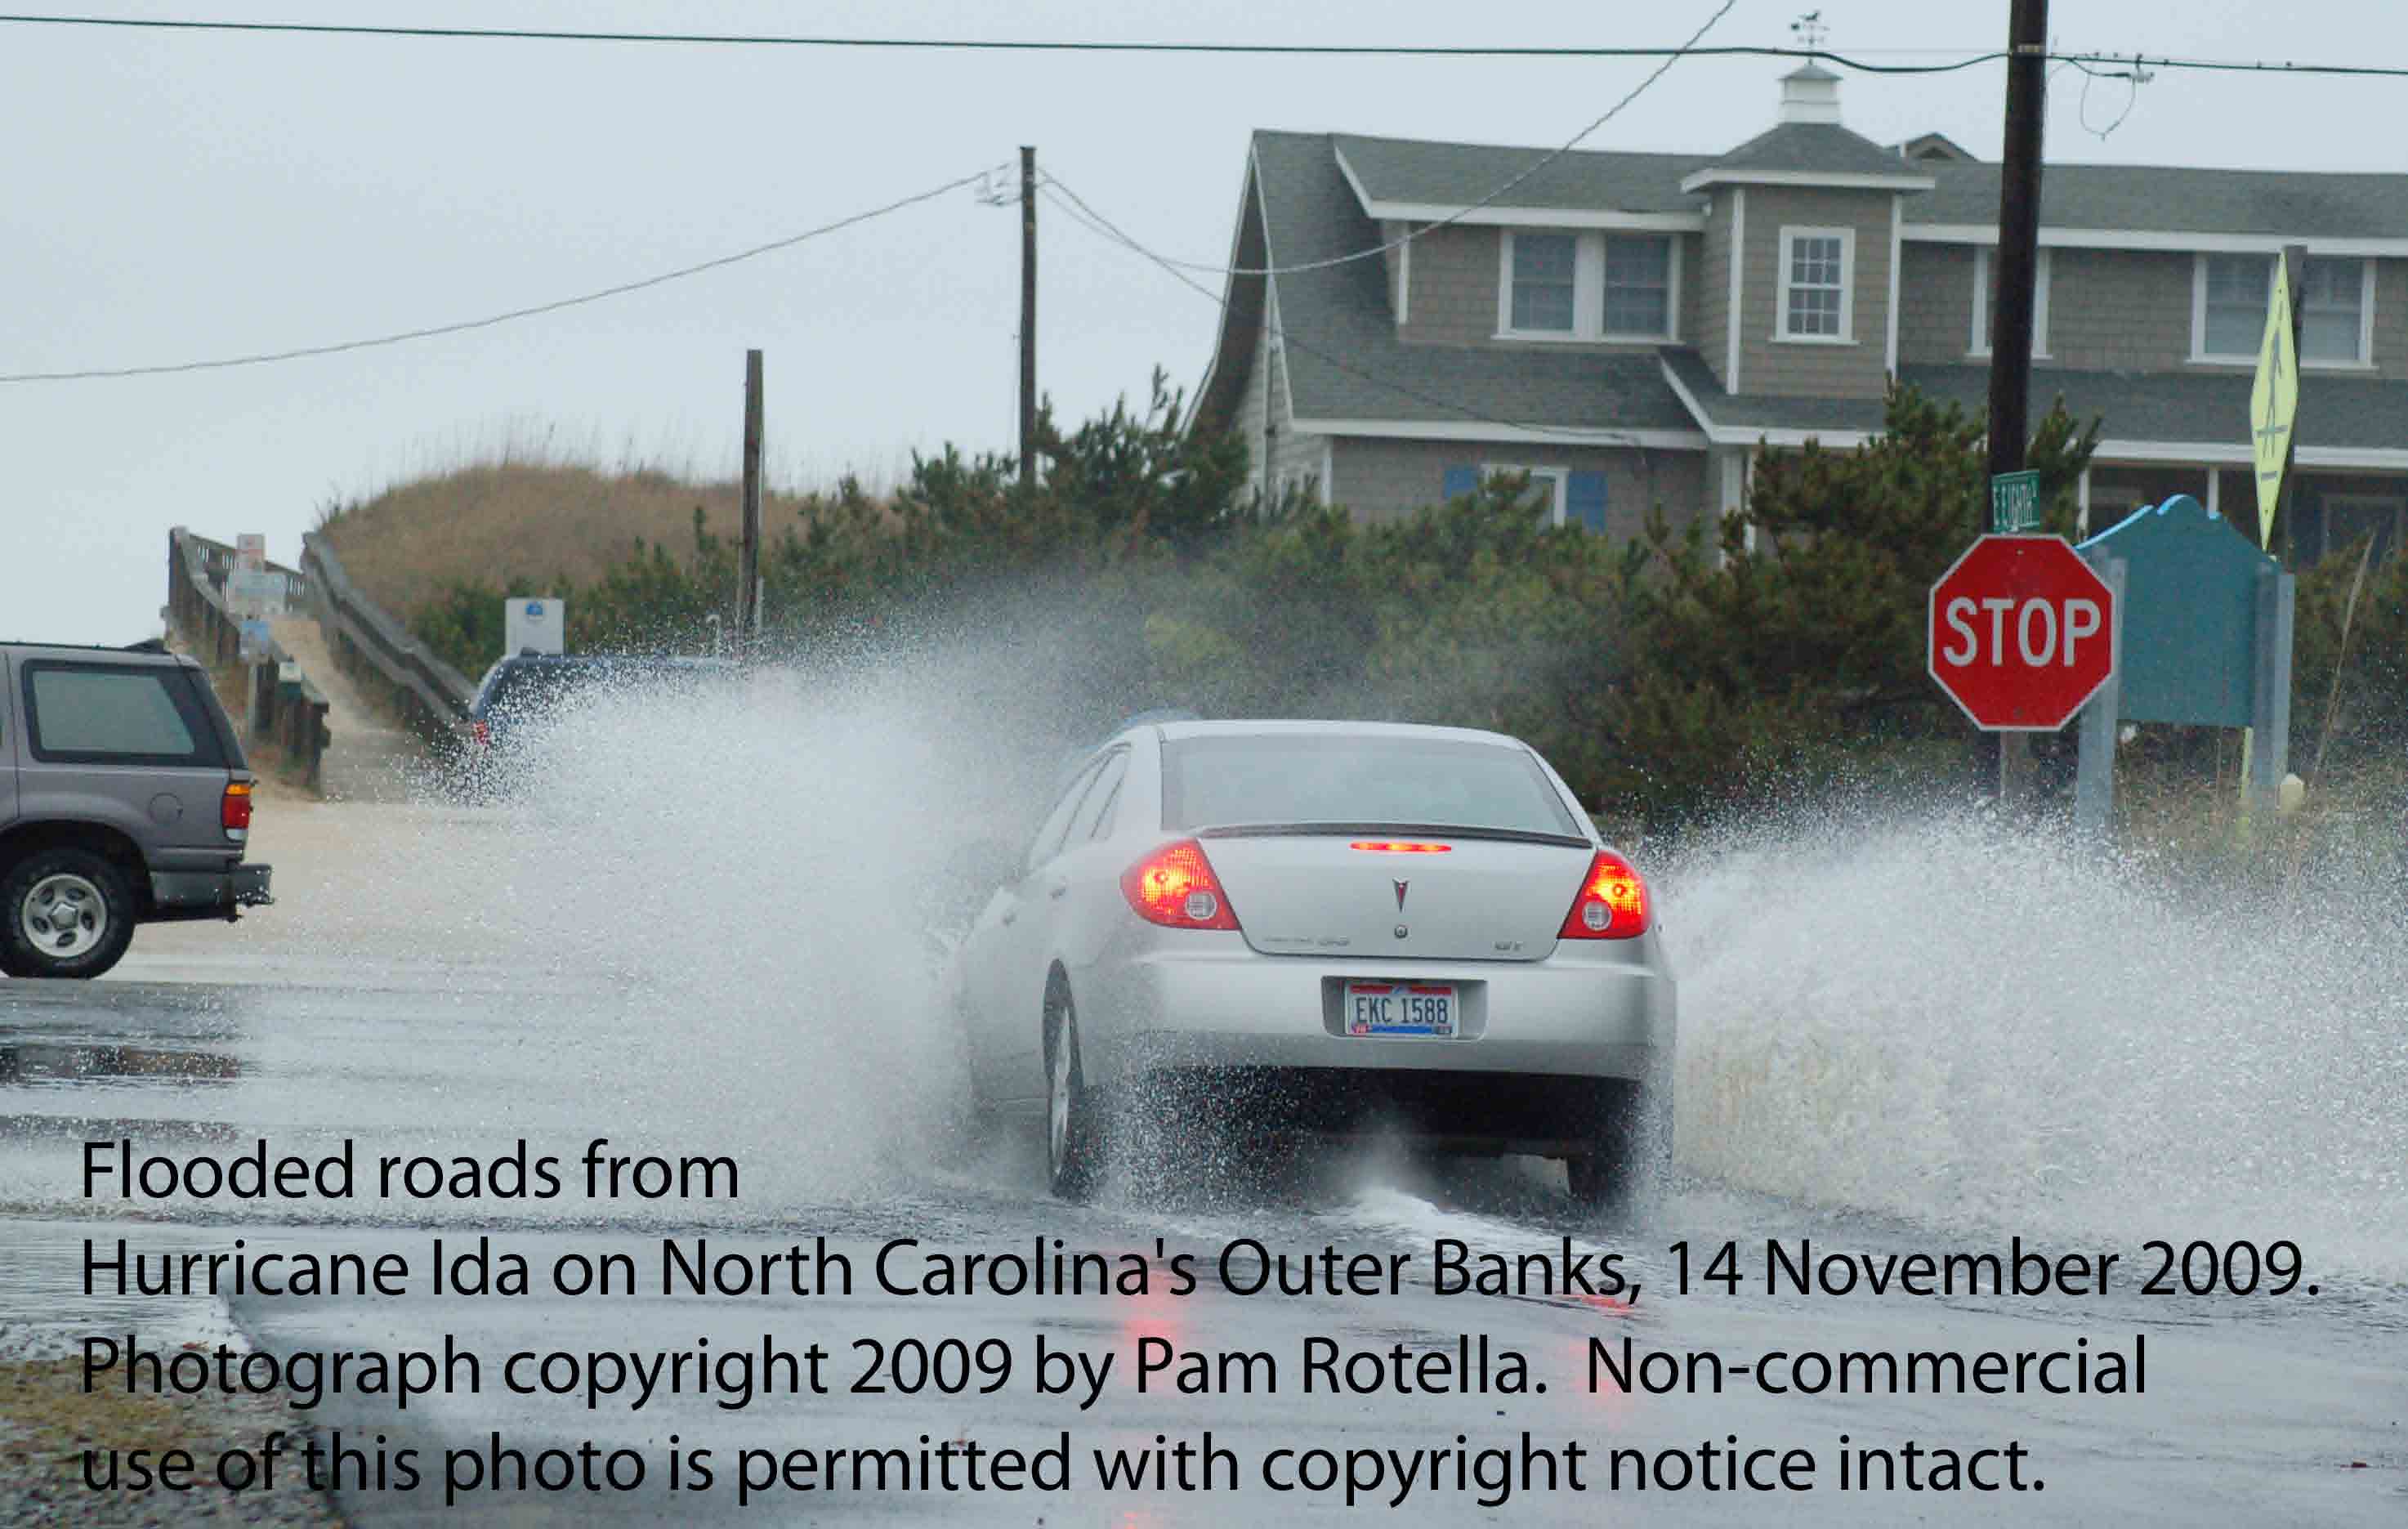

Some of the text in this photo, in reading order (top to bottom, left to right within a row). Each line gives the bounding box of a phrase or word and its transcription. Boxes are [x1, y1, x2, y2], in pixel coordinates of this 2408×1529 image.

[1942, 597, 2102, 668] STOP
[1356, 998, 1449, 1024] EKC 1588
